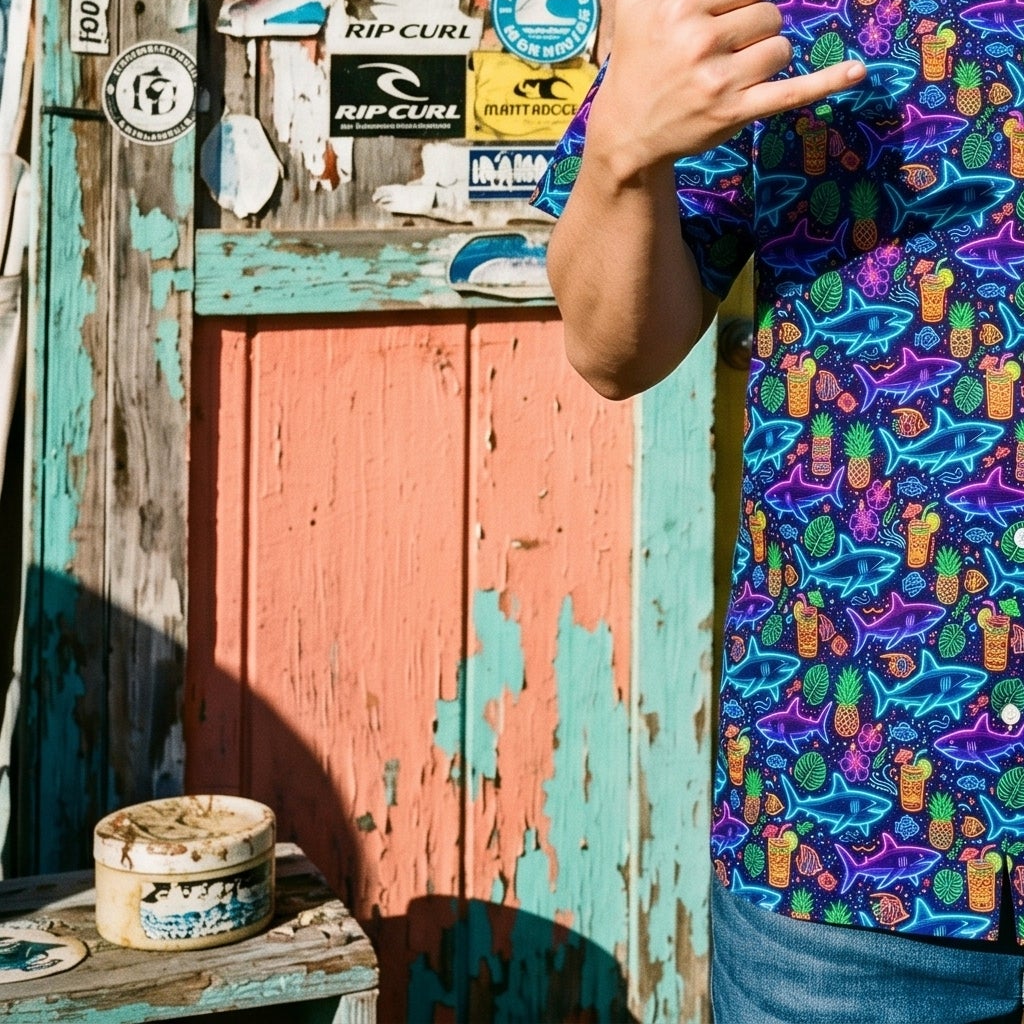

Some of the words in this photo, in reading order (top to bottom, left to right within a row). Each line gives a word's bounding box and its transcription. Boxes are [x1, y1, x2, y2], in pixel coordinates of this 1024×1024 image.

[345, 23, 395, 39] RIP
[400, 24, 472, 39] CURL
[334, 104, 387, 120] RIP
[388, 104, 461, 120] CURL
